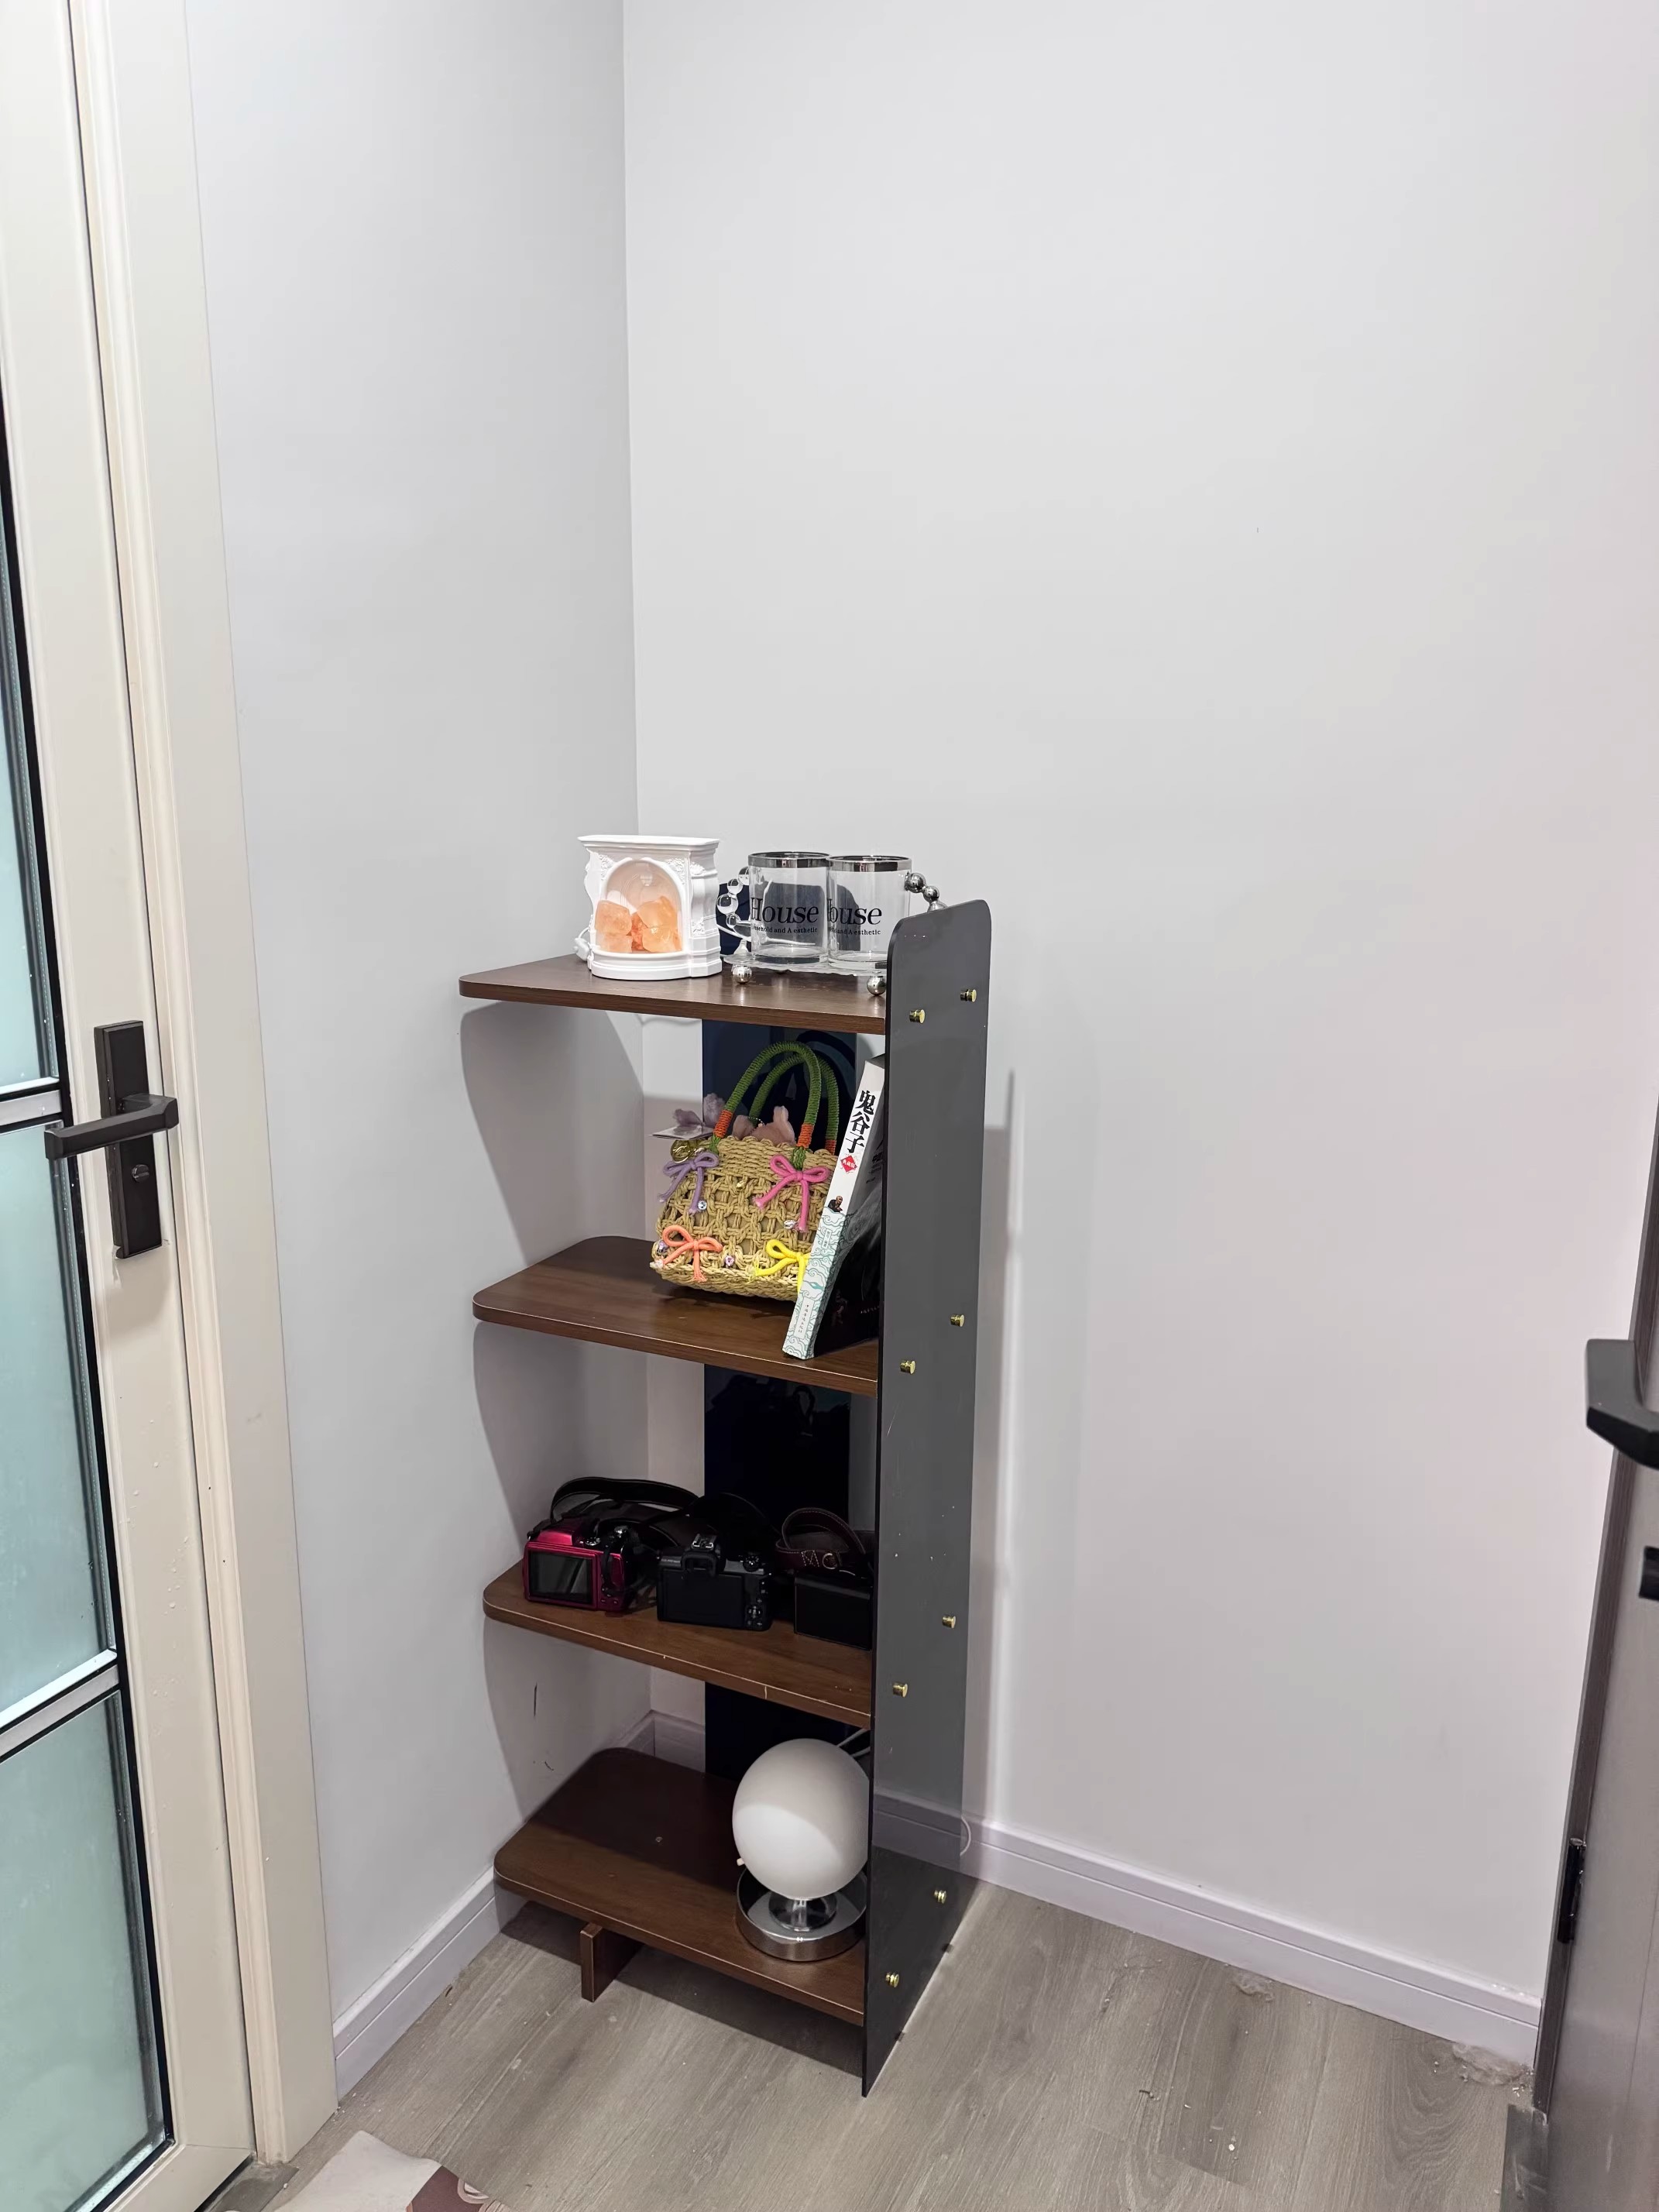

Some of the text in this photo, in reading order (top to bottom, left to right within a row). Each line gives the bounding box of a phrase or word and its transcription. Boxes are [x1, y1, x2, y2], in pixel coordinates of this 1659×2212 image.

[750, 897, 819, 923] House
[845, 1090, 876, 1153] 鬼谷子
